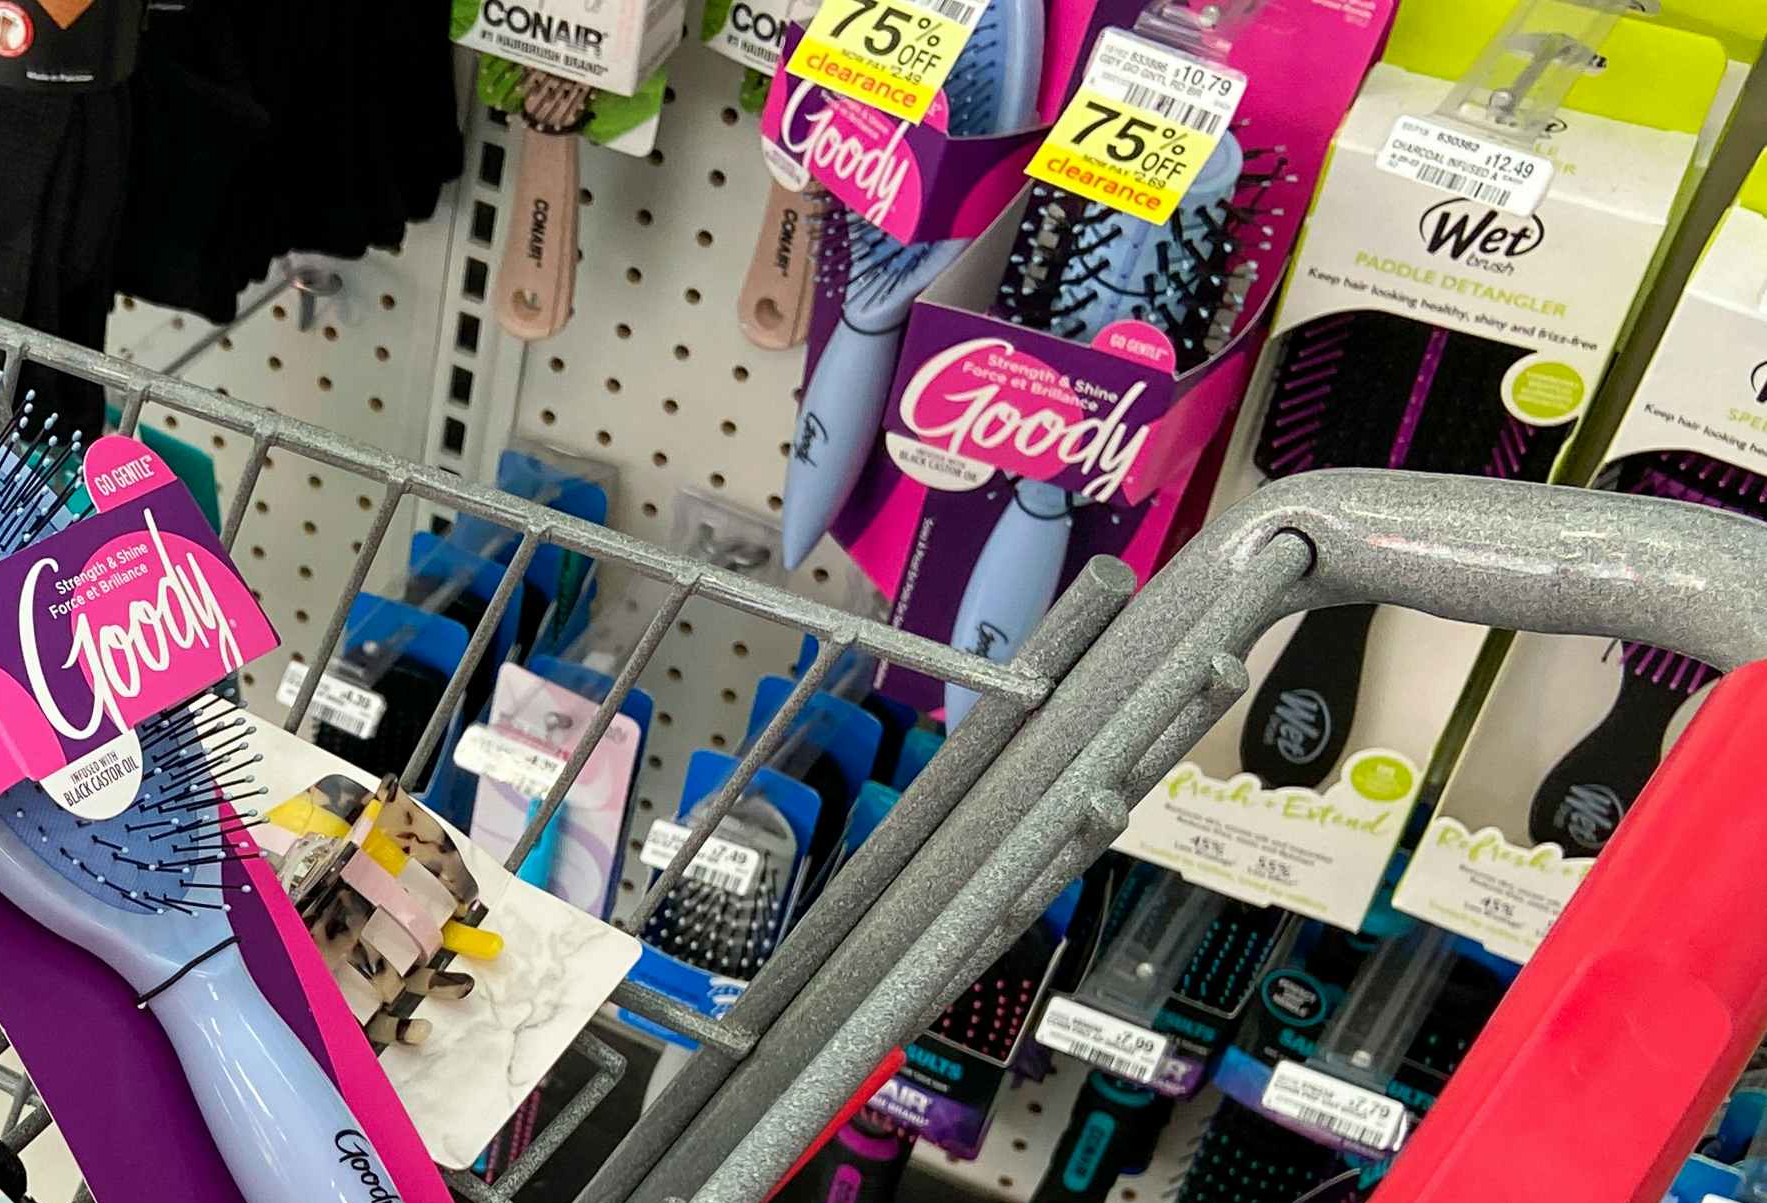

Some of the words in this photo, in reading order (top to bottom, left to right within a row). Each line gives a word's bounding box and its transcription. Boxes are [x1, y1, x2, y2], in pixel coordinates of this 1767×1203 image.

[483, 0, 603, 53] CONAIR
[806, 53, 918, 109] clearance
[897, 44, 942, 74] OFF
[780, 78, 910, 227] Goody
[1141, 152, 1187, 180] OFF
[1046, 156, 1162, 211] clearance
[530, 198, 550, 266] CONAIR
[1425, 209, 1533, 261] Wet
[1353, 250, 1434, 286] PADDLE
[1440, 269, 1568, 318] DETANGLER
[1465, 252, 1516, 276] brush
[1307, 267, 1342, 290] Keep
[1342, 276, 1368, 292] hair
[1370, 282, 1418, 309] looking
[1473, 312, 1508, 333] shiny
[1509, 322, 1535, 338] and
[962, 361, 1008, 386] Force
[1010, 376, 1027, 391] et
[1031, 382, 1100, 413] Brillance
[987, 354, 1055, 385] Strength
[1060, 374, 1072, 389] &
[1074, 379, 1119, 405] Shine
[899, 337, 1150, 503] Goody
[94, 474, 117, 497] GO
[112, 459, 155, 491] GENTLE
[48, 592, 86, 620] Force
[85, 584, 101, 601] et
[99, 560, 150, 593] Brillance
[54, 562, 107, 597] Strength
[107, 554, 119, 570] &
[115, 540, 150, 568] Shine
[18, 507, 245, 741] Goody
[63, 783, 93, 808] BLACK
[87, 765, 124, 796] CASTOR
[120, 755, 140, 777] OIL
[70, 759, 105, 784] INFUSED
[100, 750, 120, 769] WITH
